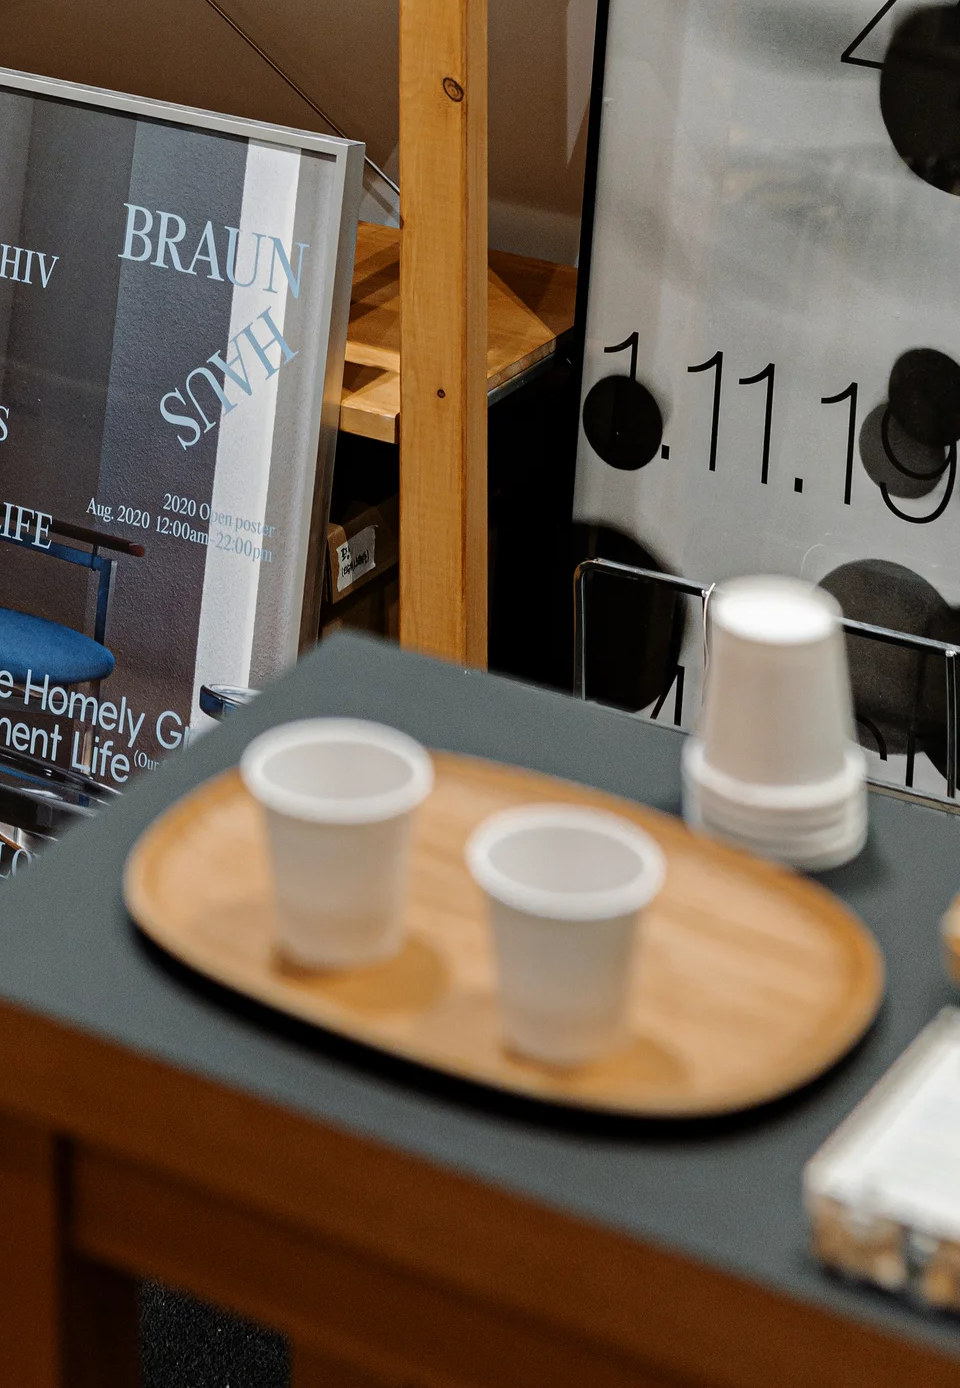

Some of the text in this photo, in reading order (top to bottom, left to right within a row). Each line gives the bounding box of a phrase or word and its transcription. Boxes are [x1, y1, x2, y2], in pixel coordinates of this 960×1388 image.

[117, 202, 310, 299] BRAUN
[159, 306, 300, 451] HAUS
[85, 496, 114, 524] Aug.
[116, 505, 151, 530] 2020
[162, 493, 277, 539] 2020 Open poster
[24, 668, 146, 749] Homely
[70, 735, 131, 784] Life
